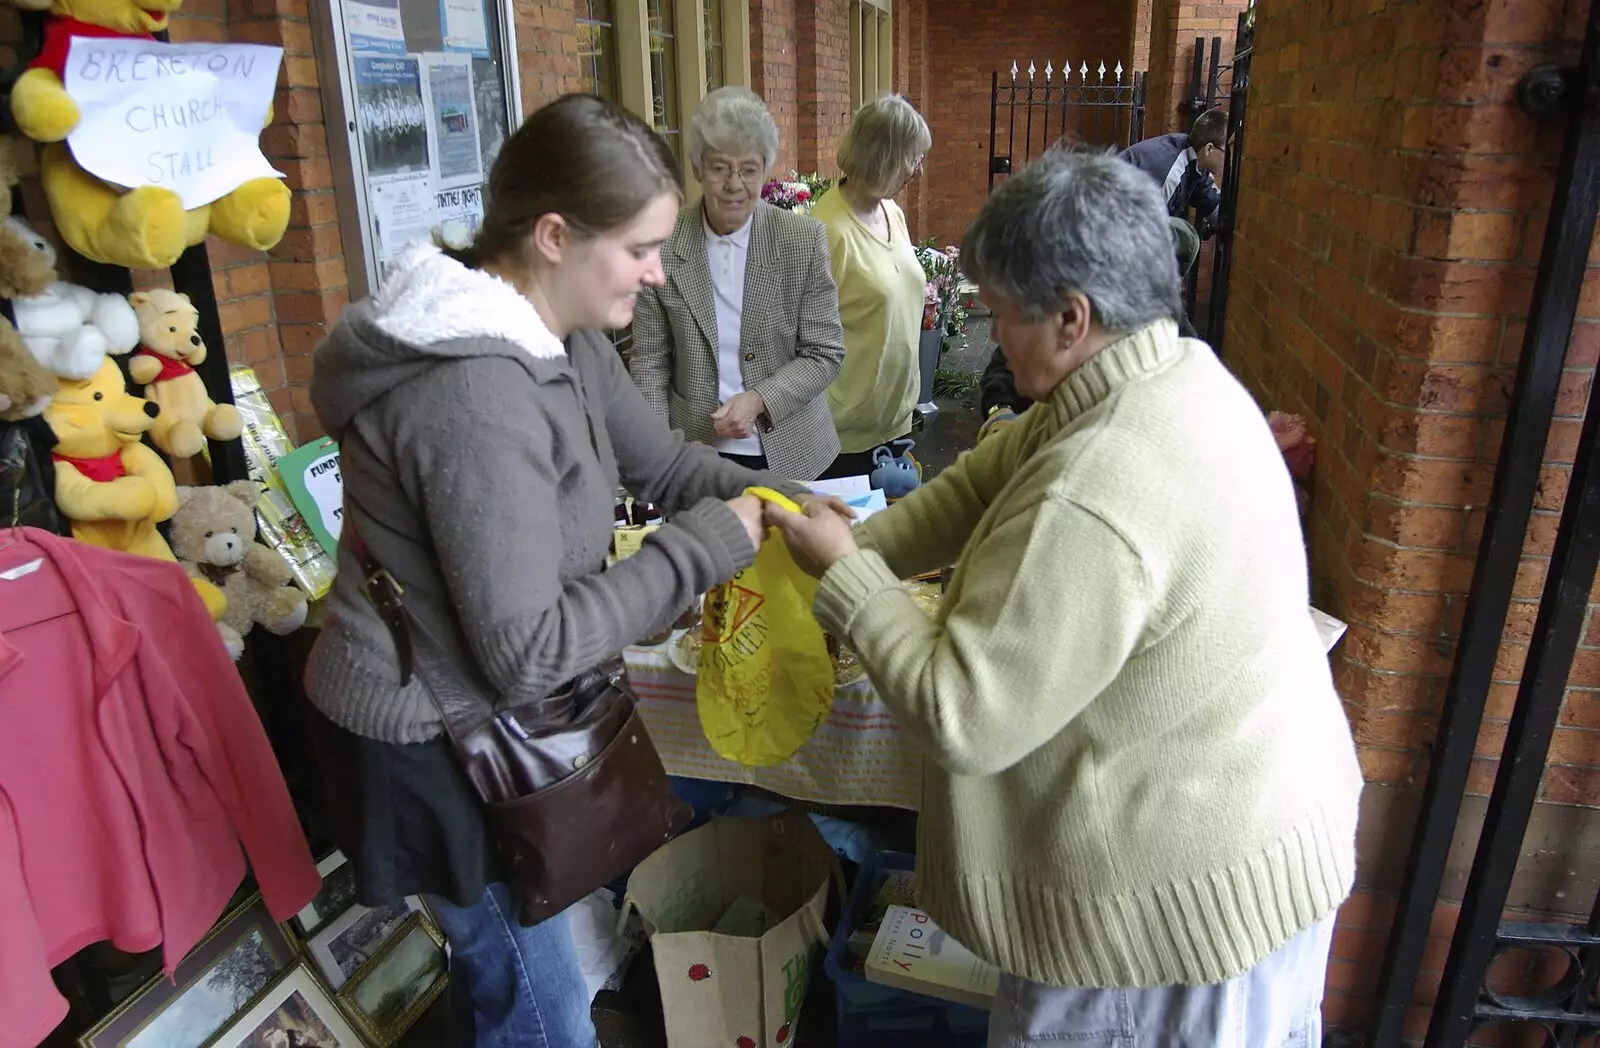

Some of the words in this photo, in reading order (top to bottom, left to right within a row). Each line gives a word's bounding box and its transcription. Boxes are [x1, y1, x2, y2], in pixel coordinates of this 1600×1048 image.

[125, 96, 224, 133] CHURCH
[147, 148, 218, 184] STALL
[893, 912, 929, 972] polly
